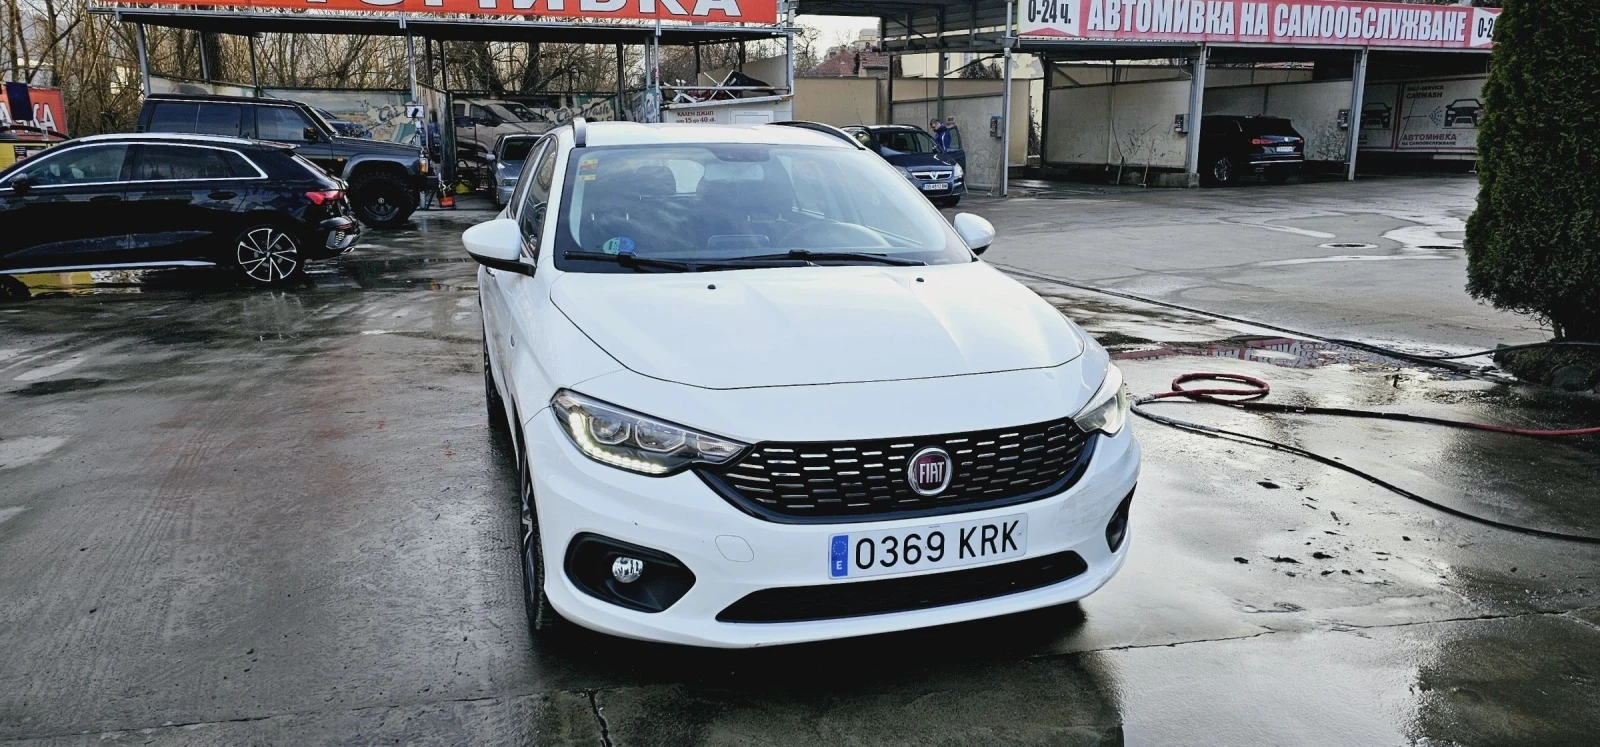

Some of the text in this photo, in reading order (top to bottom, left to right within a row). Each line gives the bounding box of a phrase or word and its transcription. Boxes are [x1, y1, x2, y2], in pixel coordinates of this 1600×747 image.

[1028, 0, 1071, 24] 0-24 ч.
[1087, 0, 1467, 41] АВТОМИВКА НА САМООБСЛУЖВАНЕ
[1477, 17, 1494, 38] 0-2
[919, 461, 945, 484] FIAT
[836, 520, 1019, 570] E 0369 KRK
